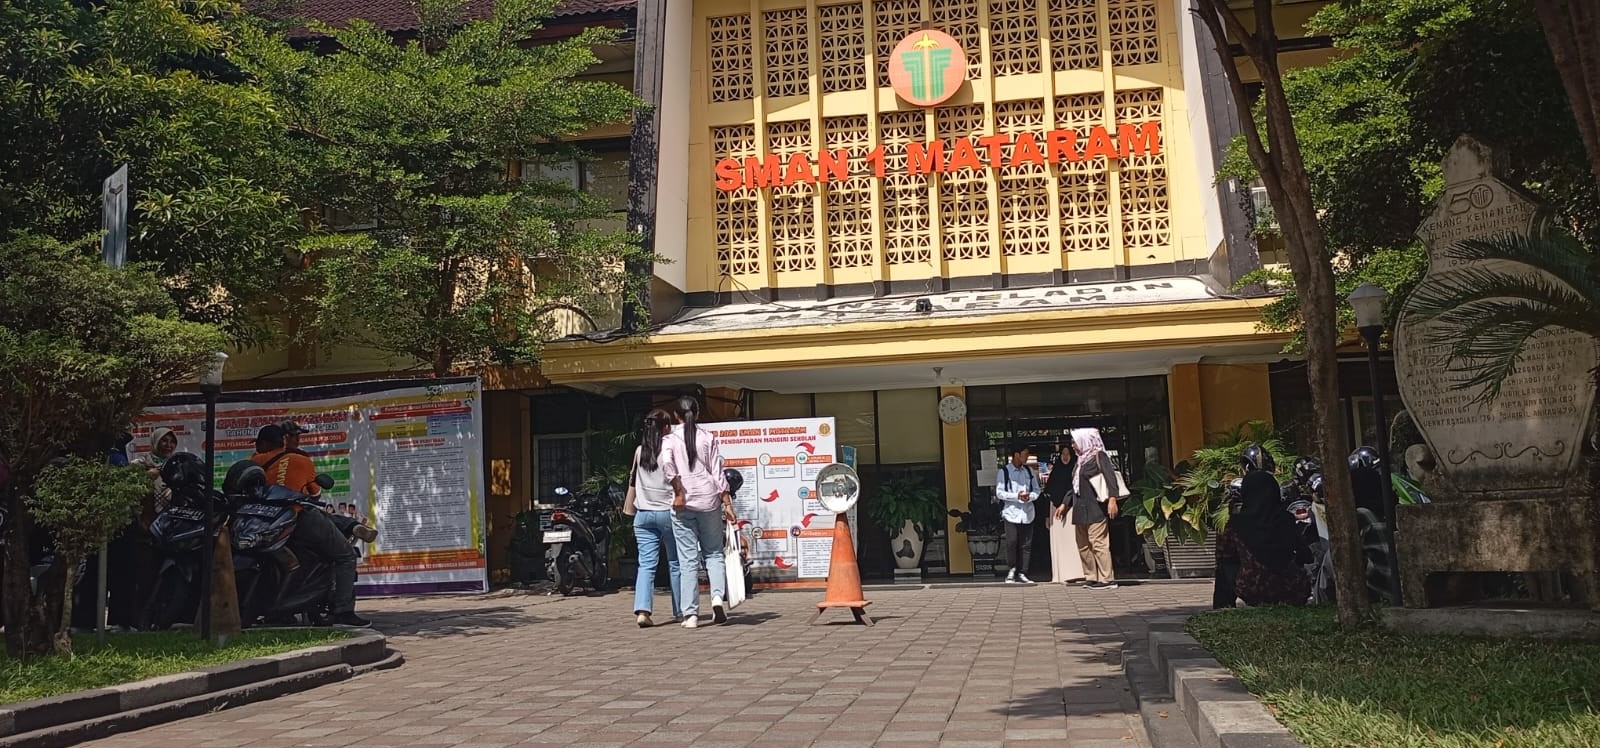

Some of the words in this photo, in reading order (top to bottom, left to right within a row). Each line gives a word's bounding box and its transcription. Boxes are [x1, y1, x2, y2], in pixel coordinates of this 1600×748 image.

[715, 149, 848, 191] SMAN
[867, 145, 885, 178] 1
[907, 121, 1162, 176] MATARAM
[943, 282, 1174, 303] TELADAN
